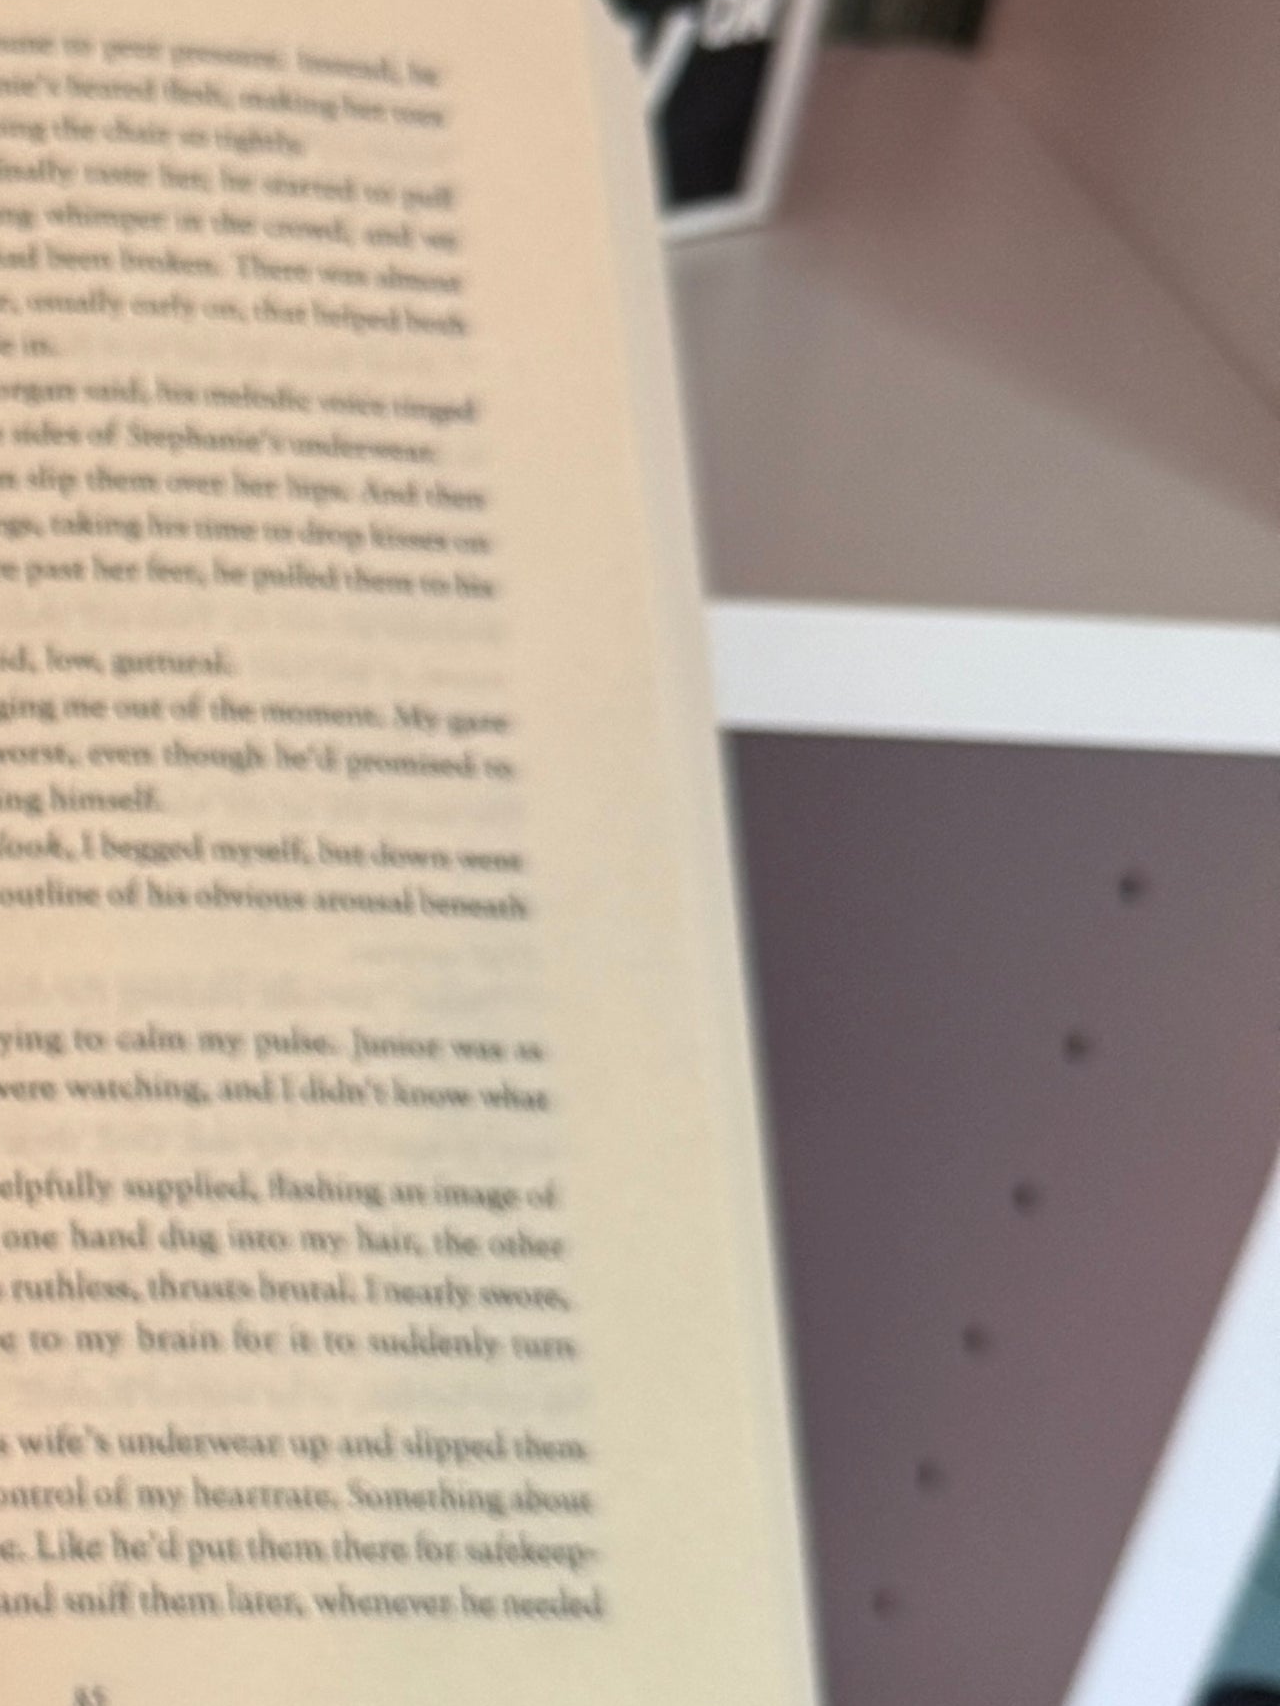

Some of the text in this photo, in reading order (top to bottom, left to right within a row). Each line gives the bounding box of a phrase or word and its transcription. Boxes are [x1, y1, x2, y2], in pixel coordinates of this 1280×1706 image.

[94, 1476, 132, 1510] of
[137, 1486, 187, 1518] my
[348, 1478, 508, 1519] Something
[511, 1478, 592, 1512] about
[35, 1530, 106, 1563] Like
[186, 1535, 243, 1572] put
[246, 1531, 328, 1564] them
[331, 1531, 410, 1565] there
[413, 1532, 461, 1565] for
[64, 1582, 135, 1616] sniff
[140, 1583, 223, 1616] them
[315, 1584, 456, 1618] whenever
[459, 1585, 499, 1619] he
[502, 1586, 602, 1619] needed
